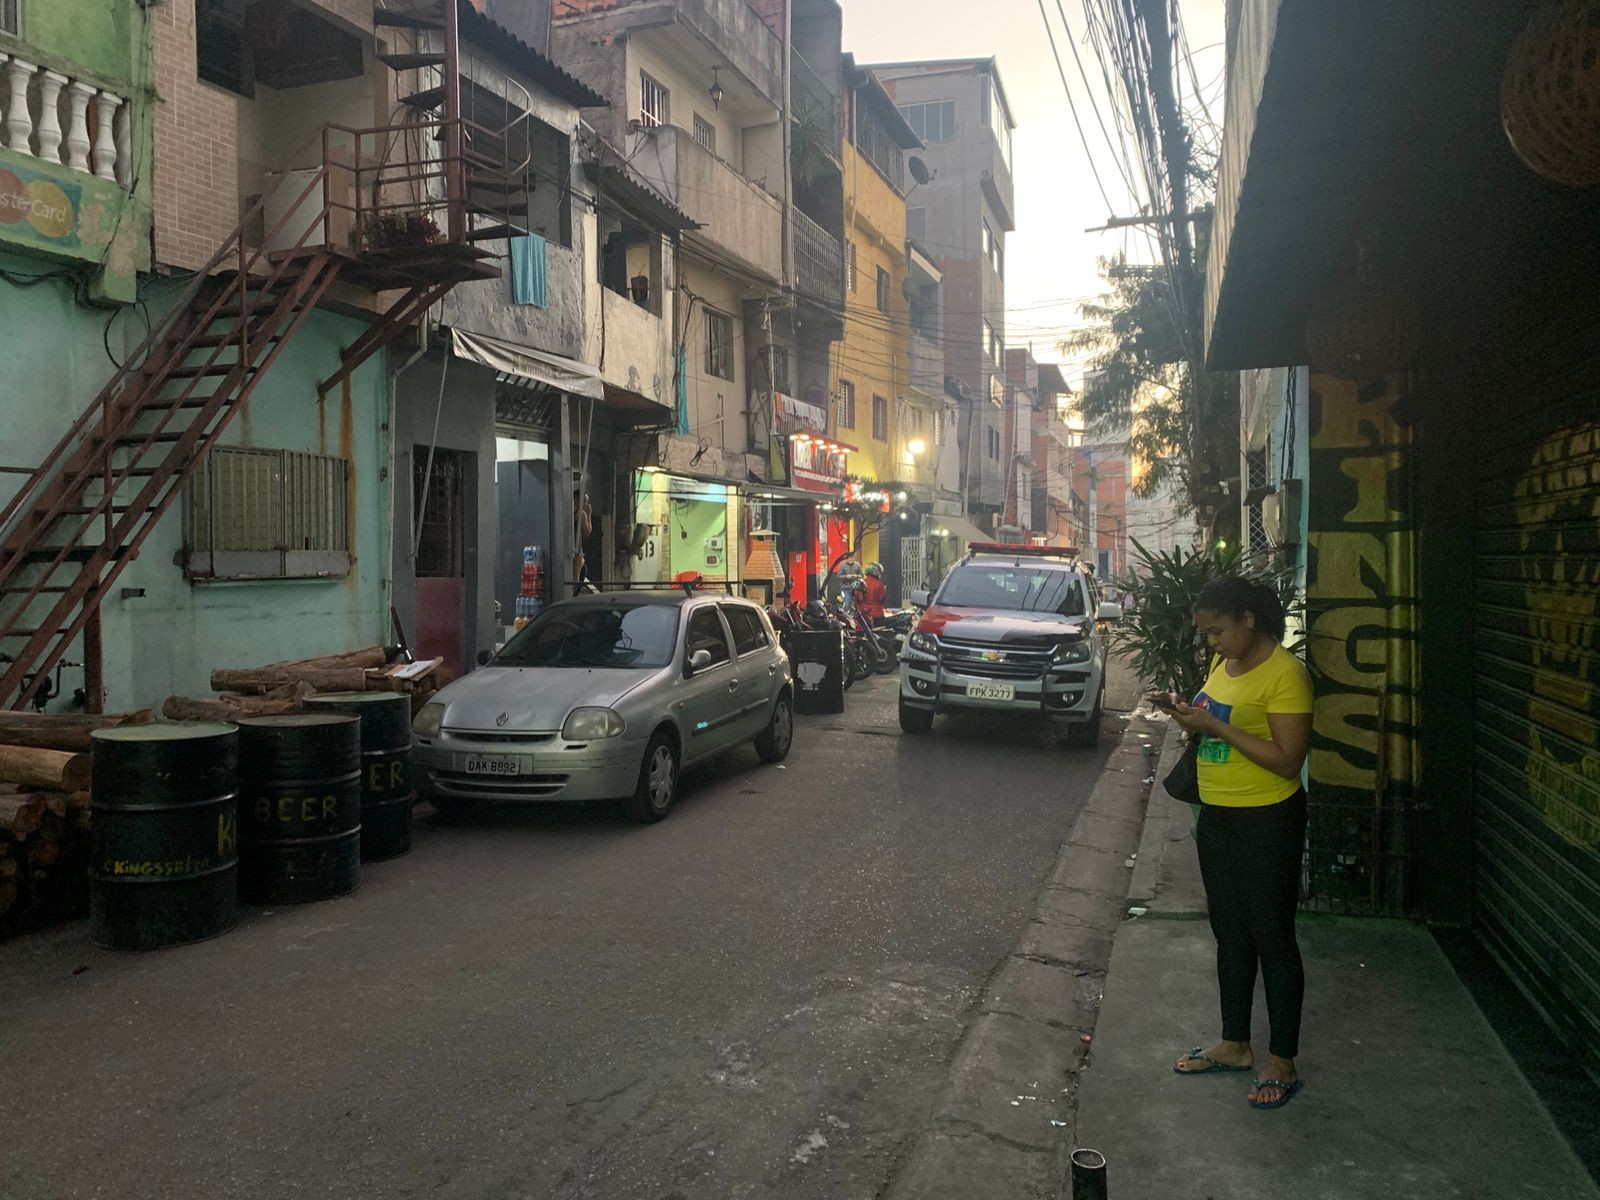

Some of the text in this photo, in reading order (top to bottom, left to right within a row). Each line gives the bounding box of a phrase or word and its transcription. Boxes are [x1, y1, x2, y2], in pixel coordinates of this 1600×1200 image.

[0, 191, 66, 222] sterCard
[1309, 372, 1422, 790] KINGS
[367, 759, 405, 791] ER
[468, 761, 488, 772] DAK
[255, 794, 338, 822] BEER
